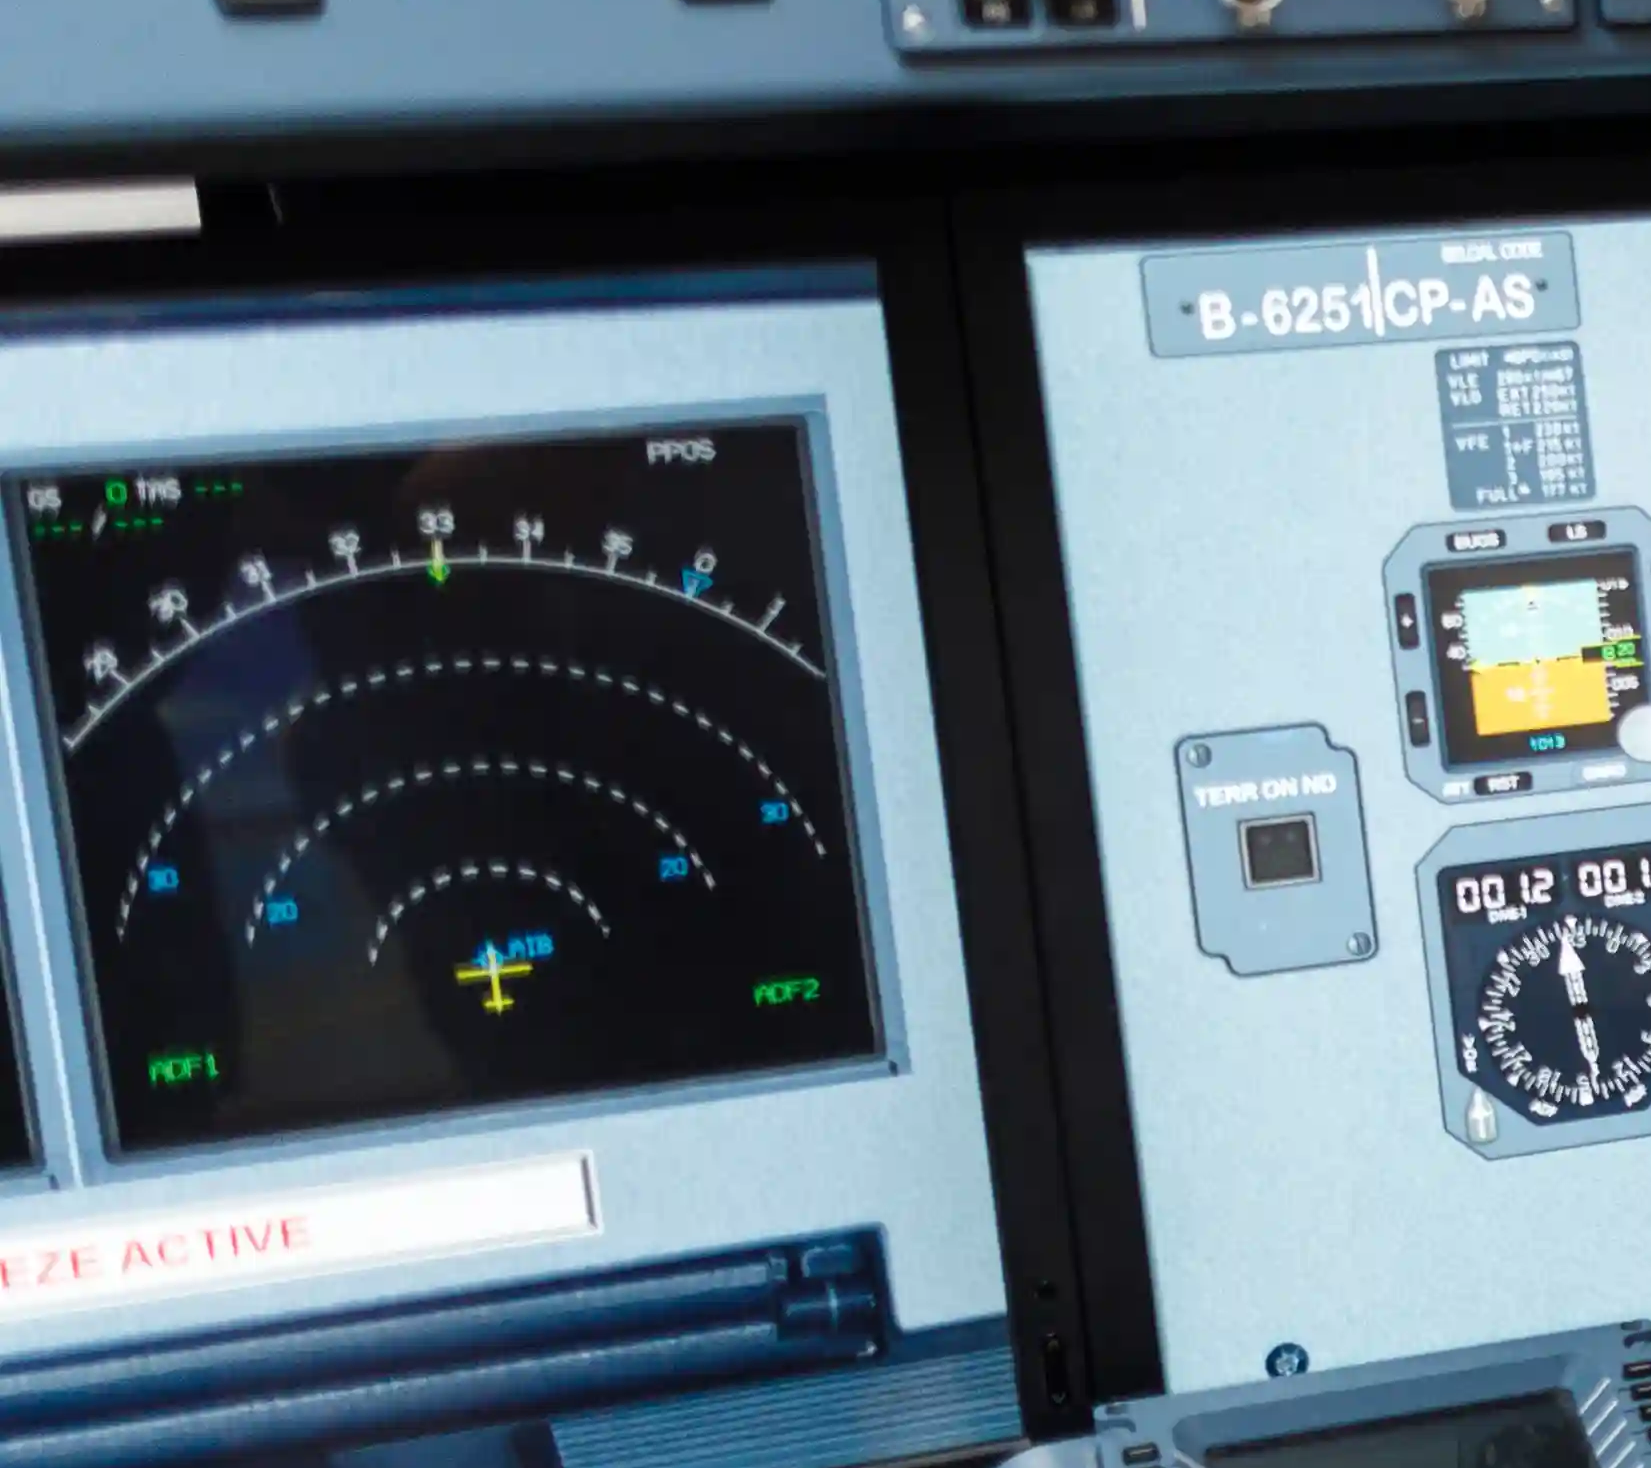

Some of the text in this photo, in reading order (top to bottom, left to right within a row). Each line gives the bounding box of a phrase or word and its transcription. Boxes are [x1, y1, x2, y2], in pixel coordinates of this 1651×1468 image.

[1197, 283, 1372, 340] B-6251
[1383, 273, 1536, 328] CP-AS
[646, 439, 716, 464] PPOS
[418, 510, 455, 534] 33
[659, 854, 689, 880] 20
[752, 977, 820, 1006] ADF2
[147, 1053, 218, 1085] ADF1
[121, 1215, 312, 1274] ACTIVE
